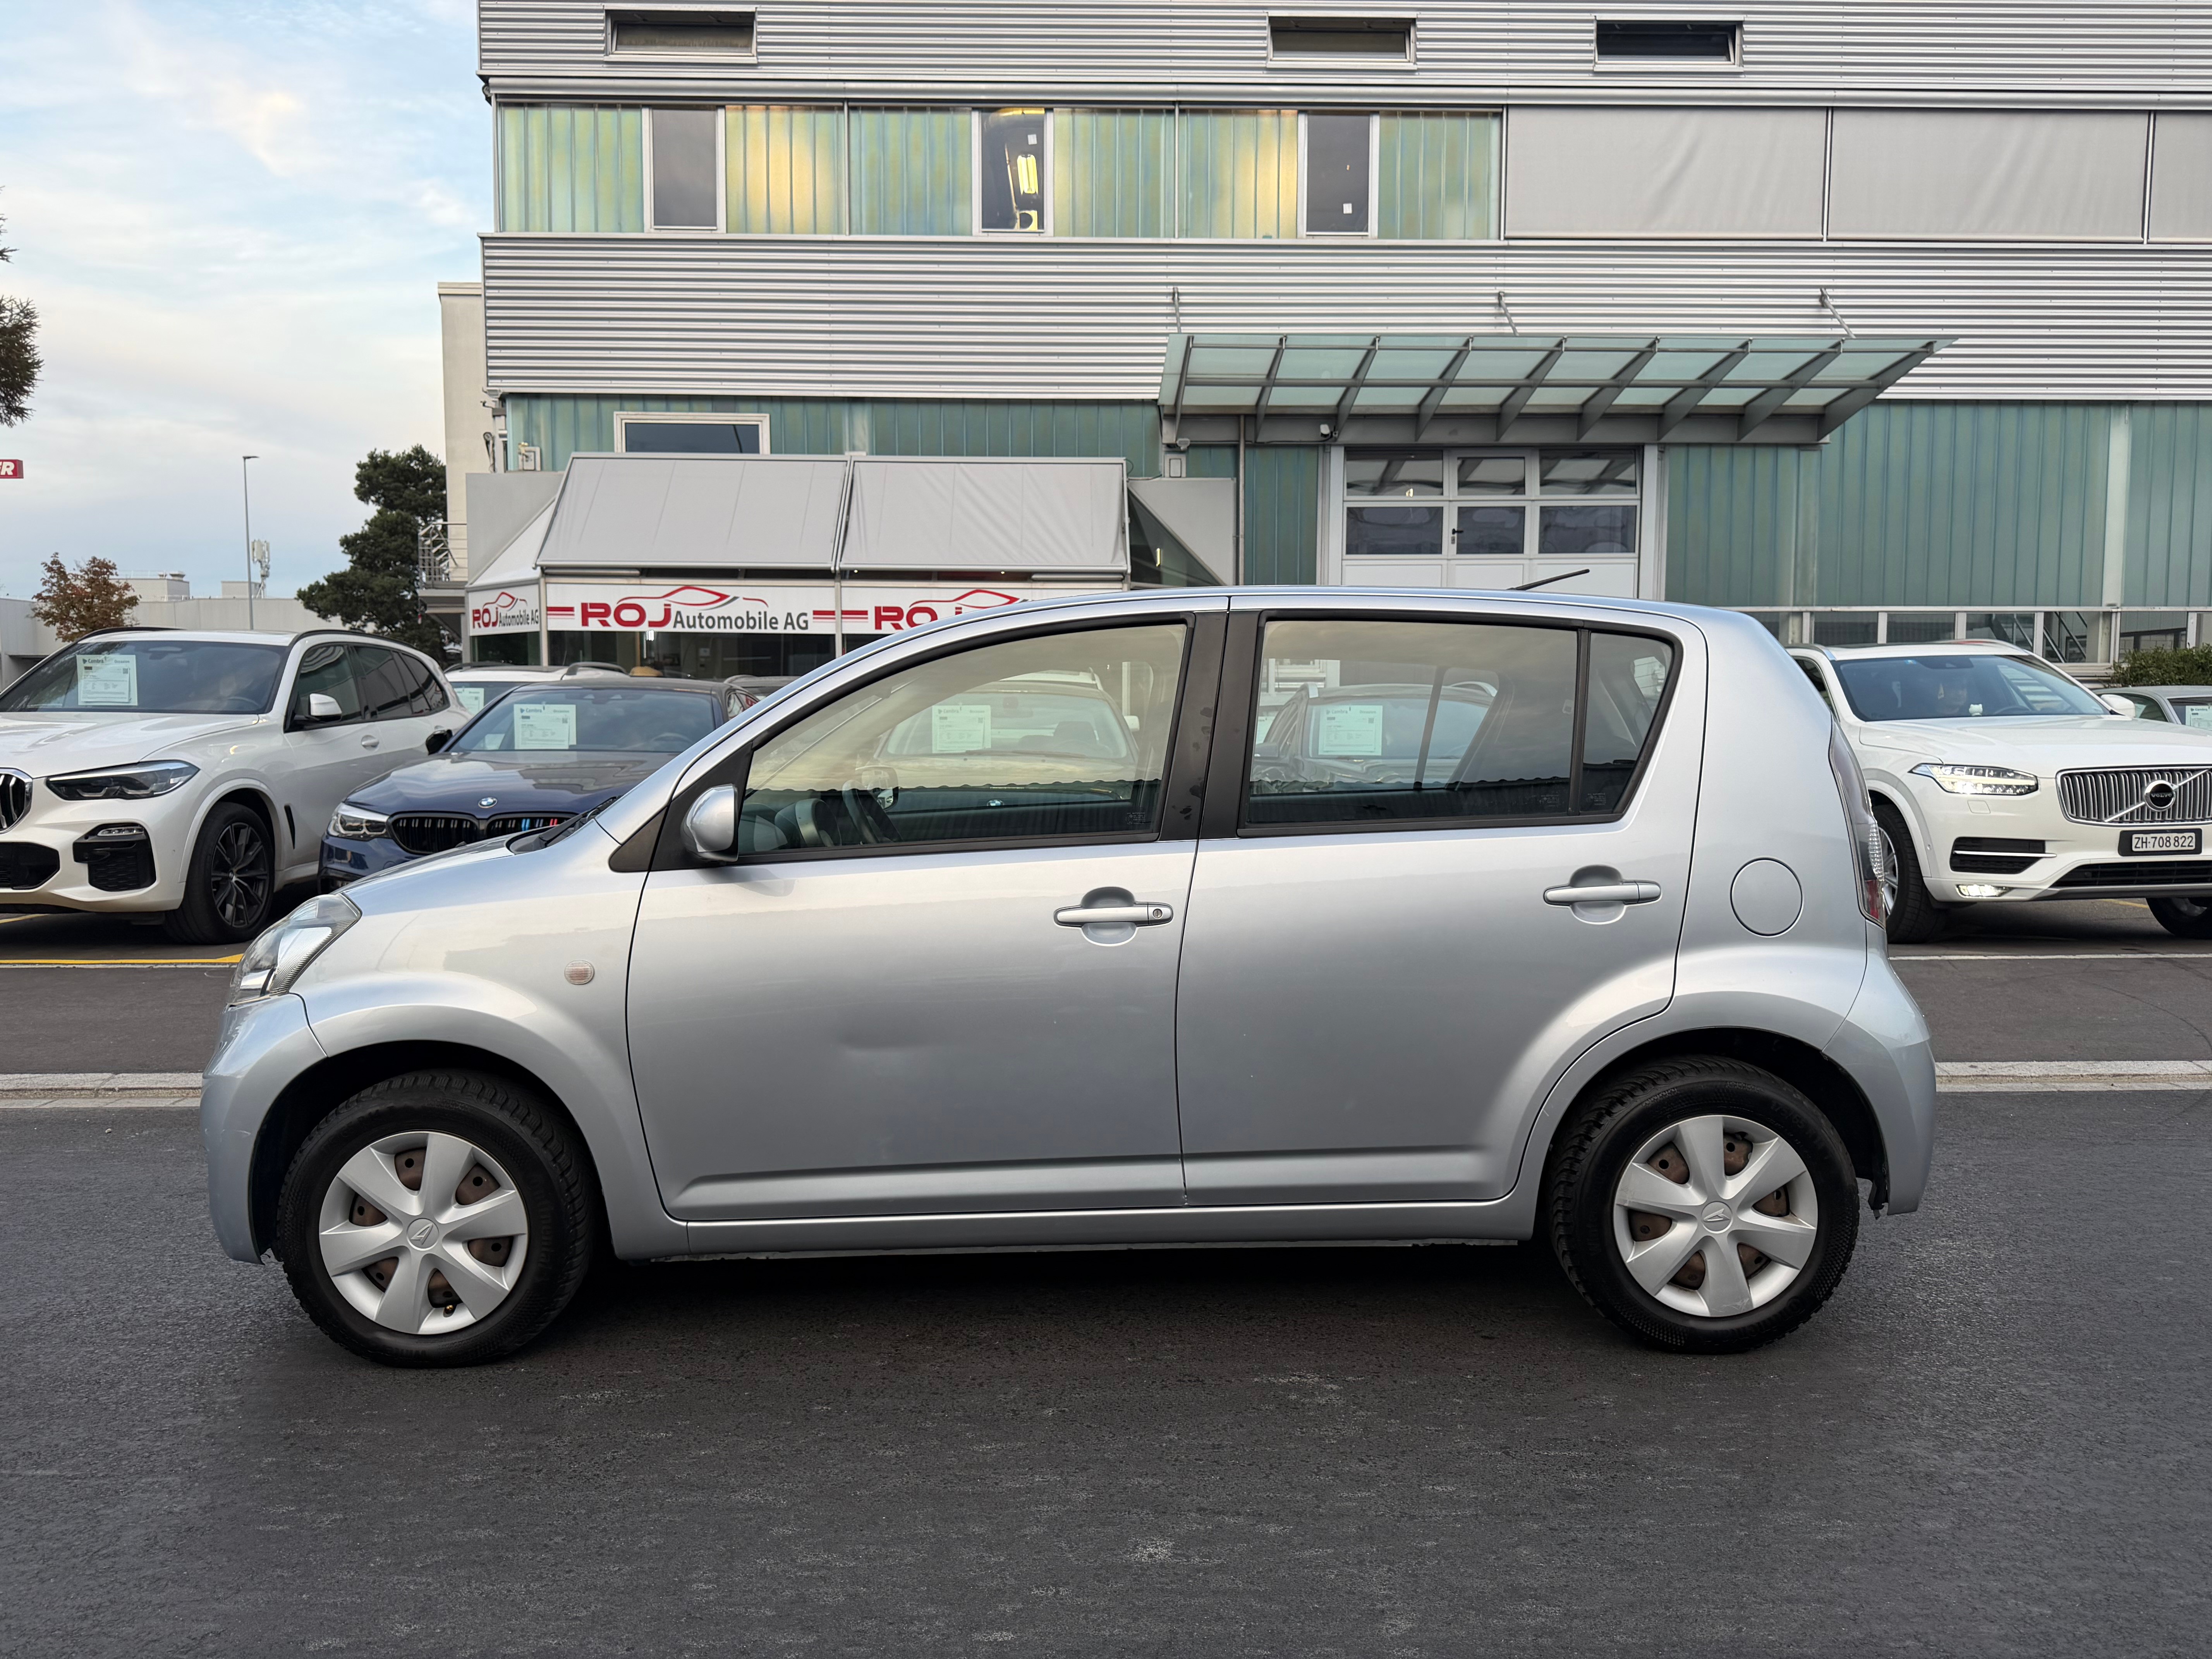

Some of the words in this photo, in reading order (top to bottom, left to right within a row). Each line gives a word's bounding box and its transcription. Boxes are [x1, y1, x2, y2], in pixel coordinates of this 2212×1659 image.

[0, 462, 14, 475] R
[472, 607, 498, 629] ROJ
[499, 609, 529, 627] Automobile
[531, 609, 539, 625] AG
[581, 603, 671, 627] ROJ
[673, 610, 778, 629] Automobile
[784, 612, 808, 630] AG
